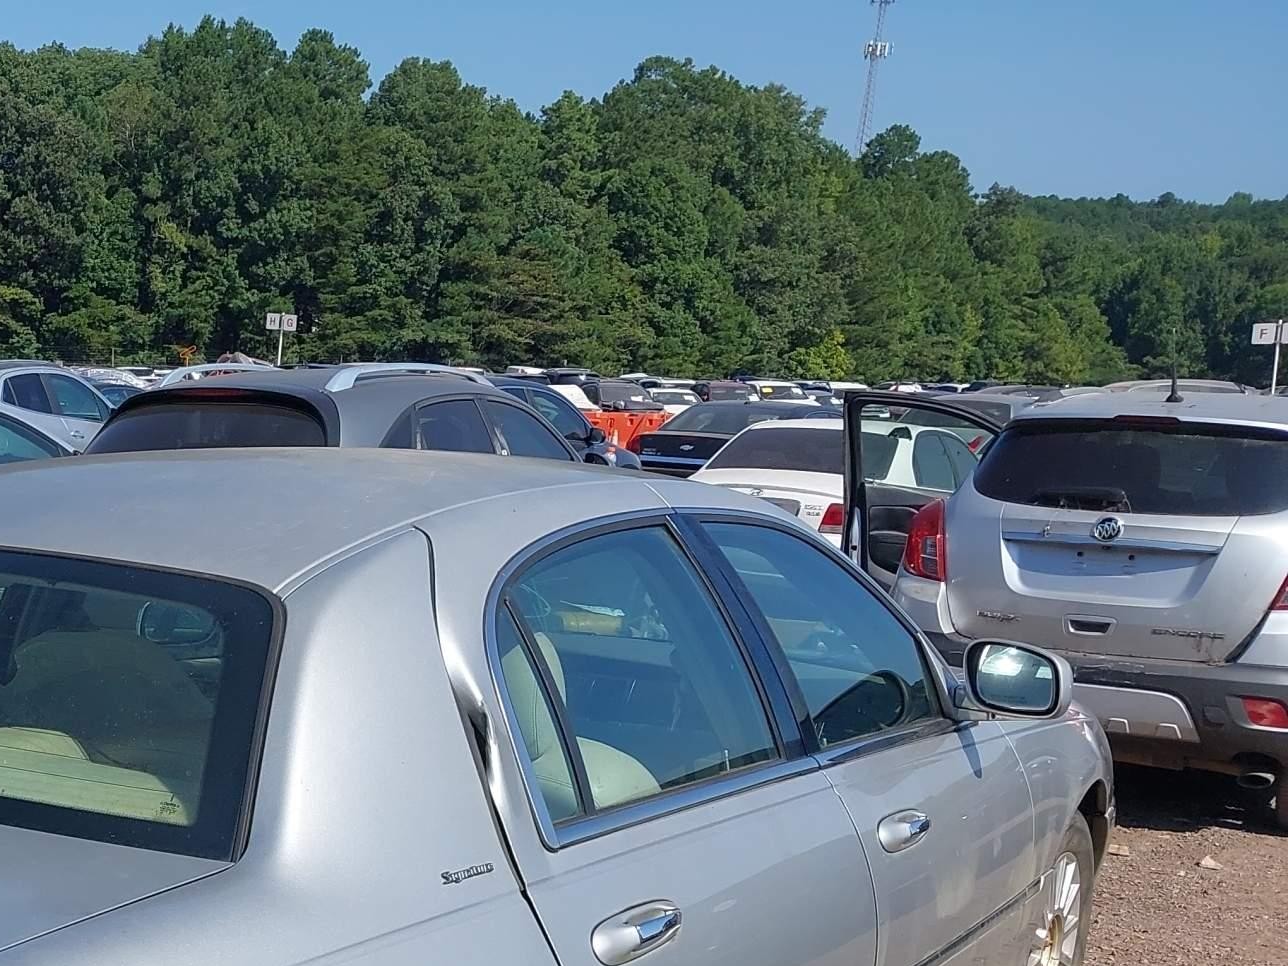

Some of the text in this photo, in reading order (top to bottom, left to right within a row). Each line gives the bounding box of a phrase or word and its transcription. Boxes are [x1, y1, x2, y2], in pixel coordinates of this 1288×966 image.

[269, 316, 276, 326] H
[286, 318, 294, 328] G
[1259, 328, 1269, 339] F
